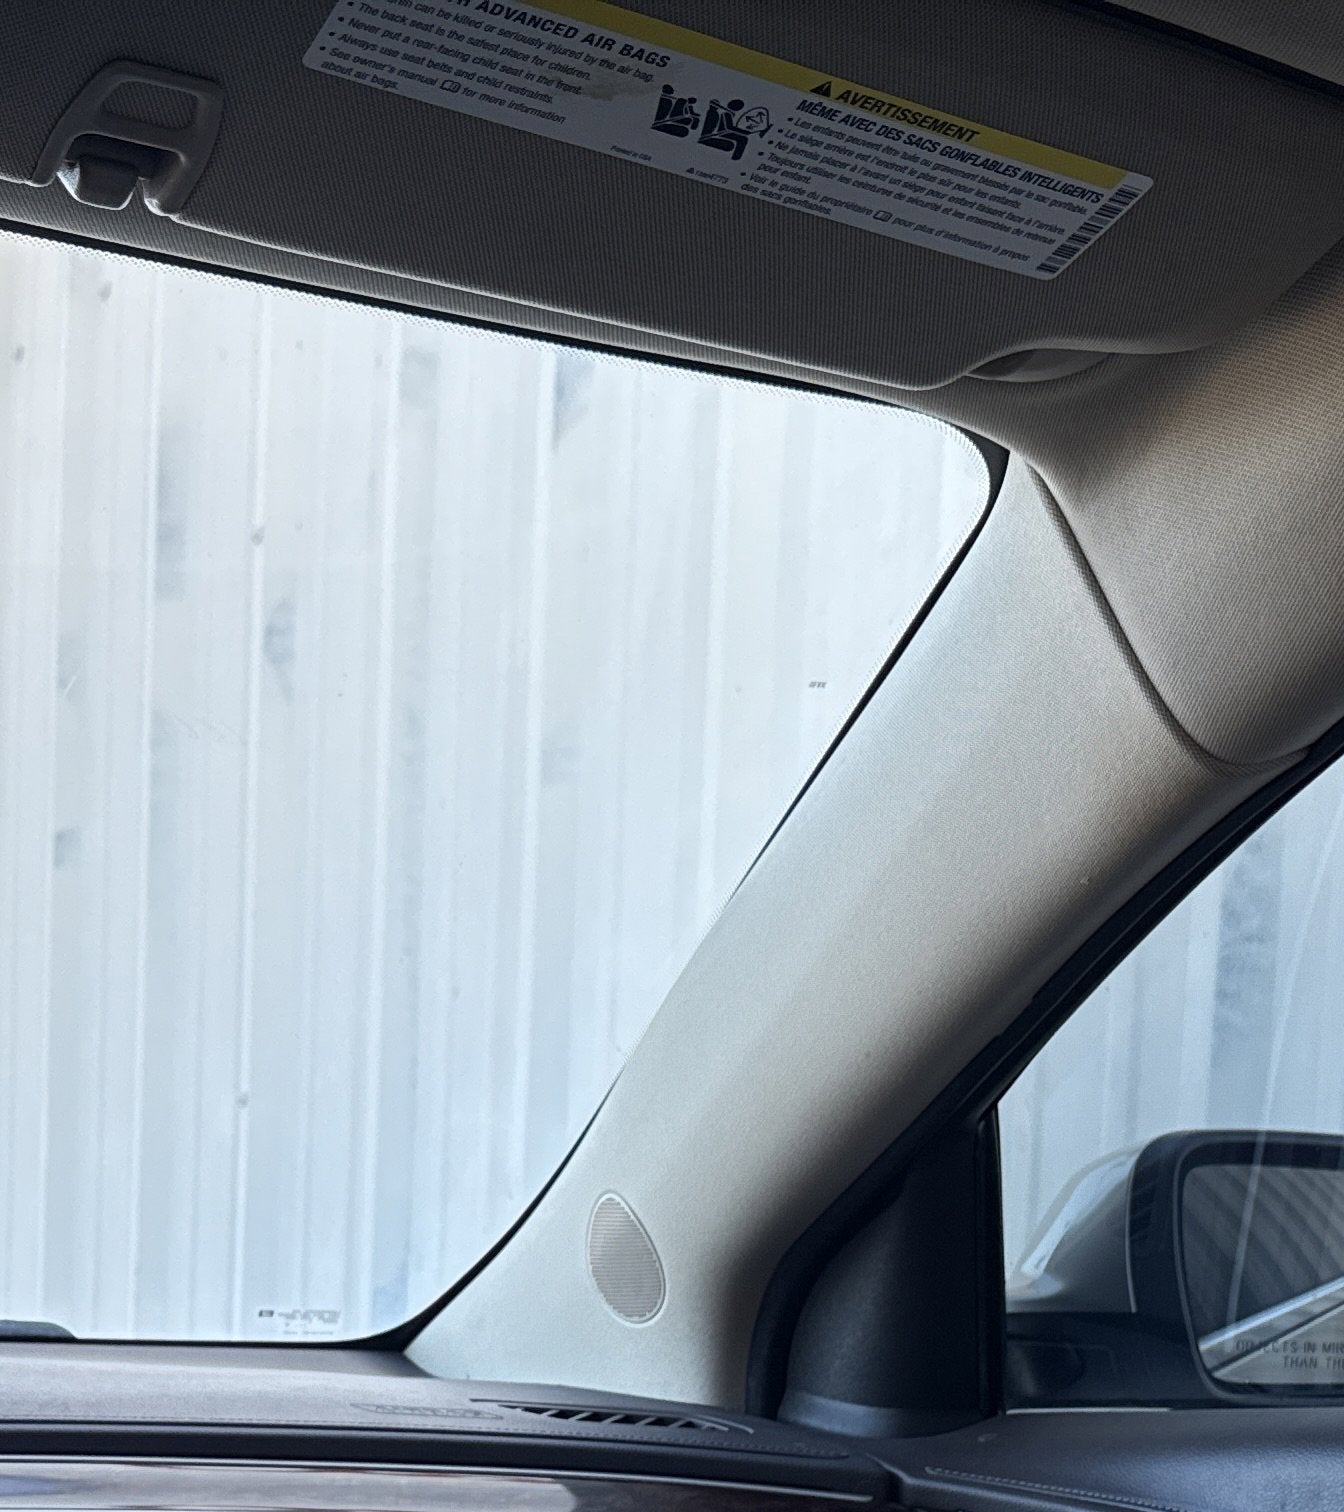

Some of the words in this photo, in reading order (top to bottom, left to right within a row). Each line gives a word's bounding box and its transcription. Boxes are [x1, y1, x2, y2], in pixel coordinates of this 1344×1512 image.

[337, 34, 378, 51] Always
[379, 47, 400, 58] use
[401, 53, 426, 66] seat
[426, 58, 453, 74] belts
[454, 69, 477, 81] and
[476, 75, 504, 88] child
[348, 17, 382, 35] Never
[380, 29, 403, 41] put
[401, 36, 411, 44] a
[412, 38, 471, 63] rear-facing
[471, 56, 500, 70] child
[498, 65, 524, 77] seat
[524, 70, 536, 81] in
[536, 75, 556, 86] the
[359, 2, 379, 16] The
[380, 9, 409, 25] back
[409, 20, 435, 33] seat
[434, 26, 446, 36] is
[446, 30, 466, 42] the
[466, 37, 501, 53] safest
[498, 47, 530, 62] place
[530, 55, 548, 66] for
[548, 62, 591, 81] children.
[414, 3, 436, 15] can
[436, 8, 453, 20] be
[452, 12, 485, 29] killed
[483, 24, 497, 33] or
[497, 28, 546, 49] seriously
[545, 41, 584, 60] injured
[582, 53, 599, 66] by
[598, 59, 617, 70] the
[616, 65, 634, 74] air
[474, 0, 579, 39] ADVANCED
[580, 33, 616, 51] AIR
[618, 43, 671, 68] BAGS
[320, 61, 354, 76] about
[353, 71, 371, 80] air
[370, 74, 399, 90] bags.
[329, 47, 352, 61] See
[352, 56, 397, 74] owner's
[397, 69, 439, 86] manual
[461, 87, 477, 98] for
[478, 93, 507, 106] more
[507, 100, 566, 125] information
[834, 89, 981, 142] AVERTISSEMENT
[796, 99, 842, 122] MÊME
[838, 114, 877, 133] AVEC
[875, 124, 905, 141] DES
[903, 134, 941, 153] SACS
[939, 146, 1021, 178] GONFLABLES
[1018, 170, 1104, 204] INTELLIGENTS
[1283, 1355, 1318, 1369] THAN
[1303, 1342, 1315, 1354] IN
